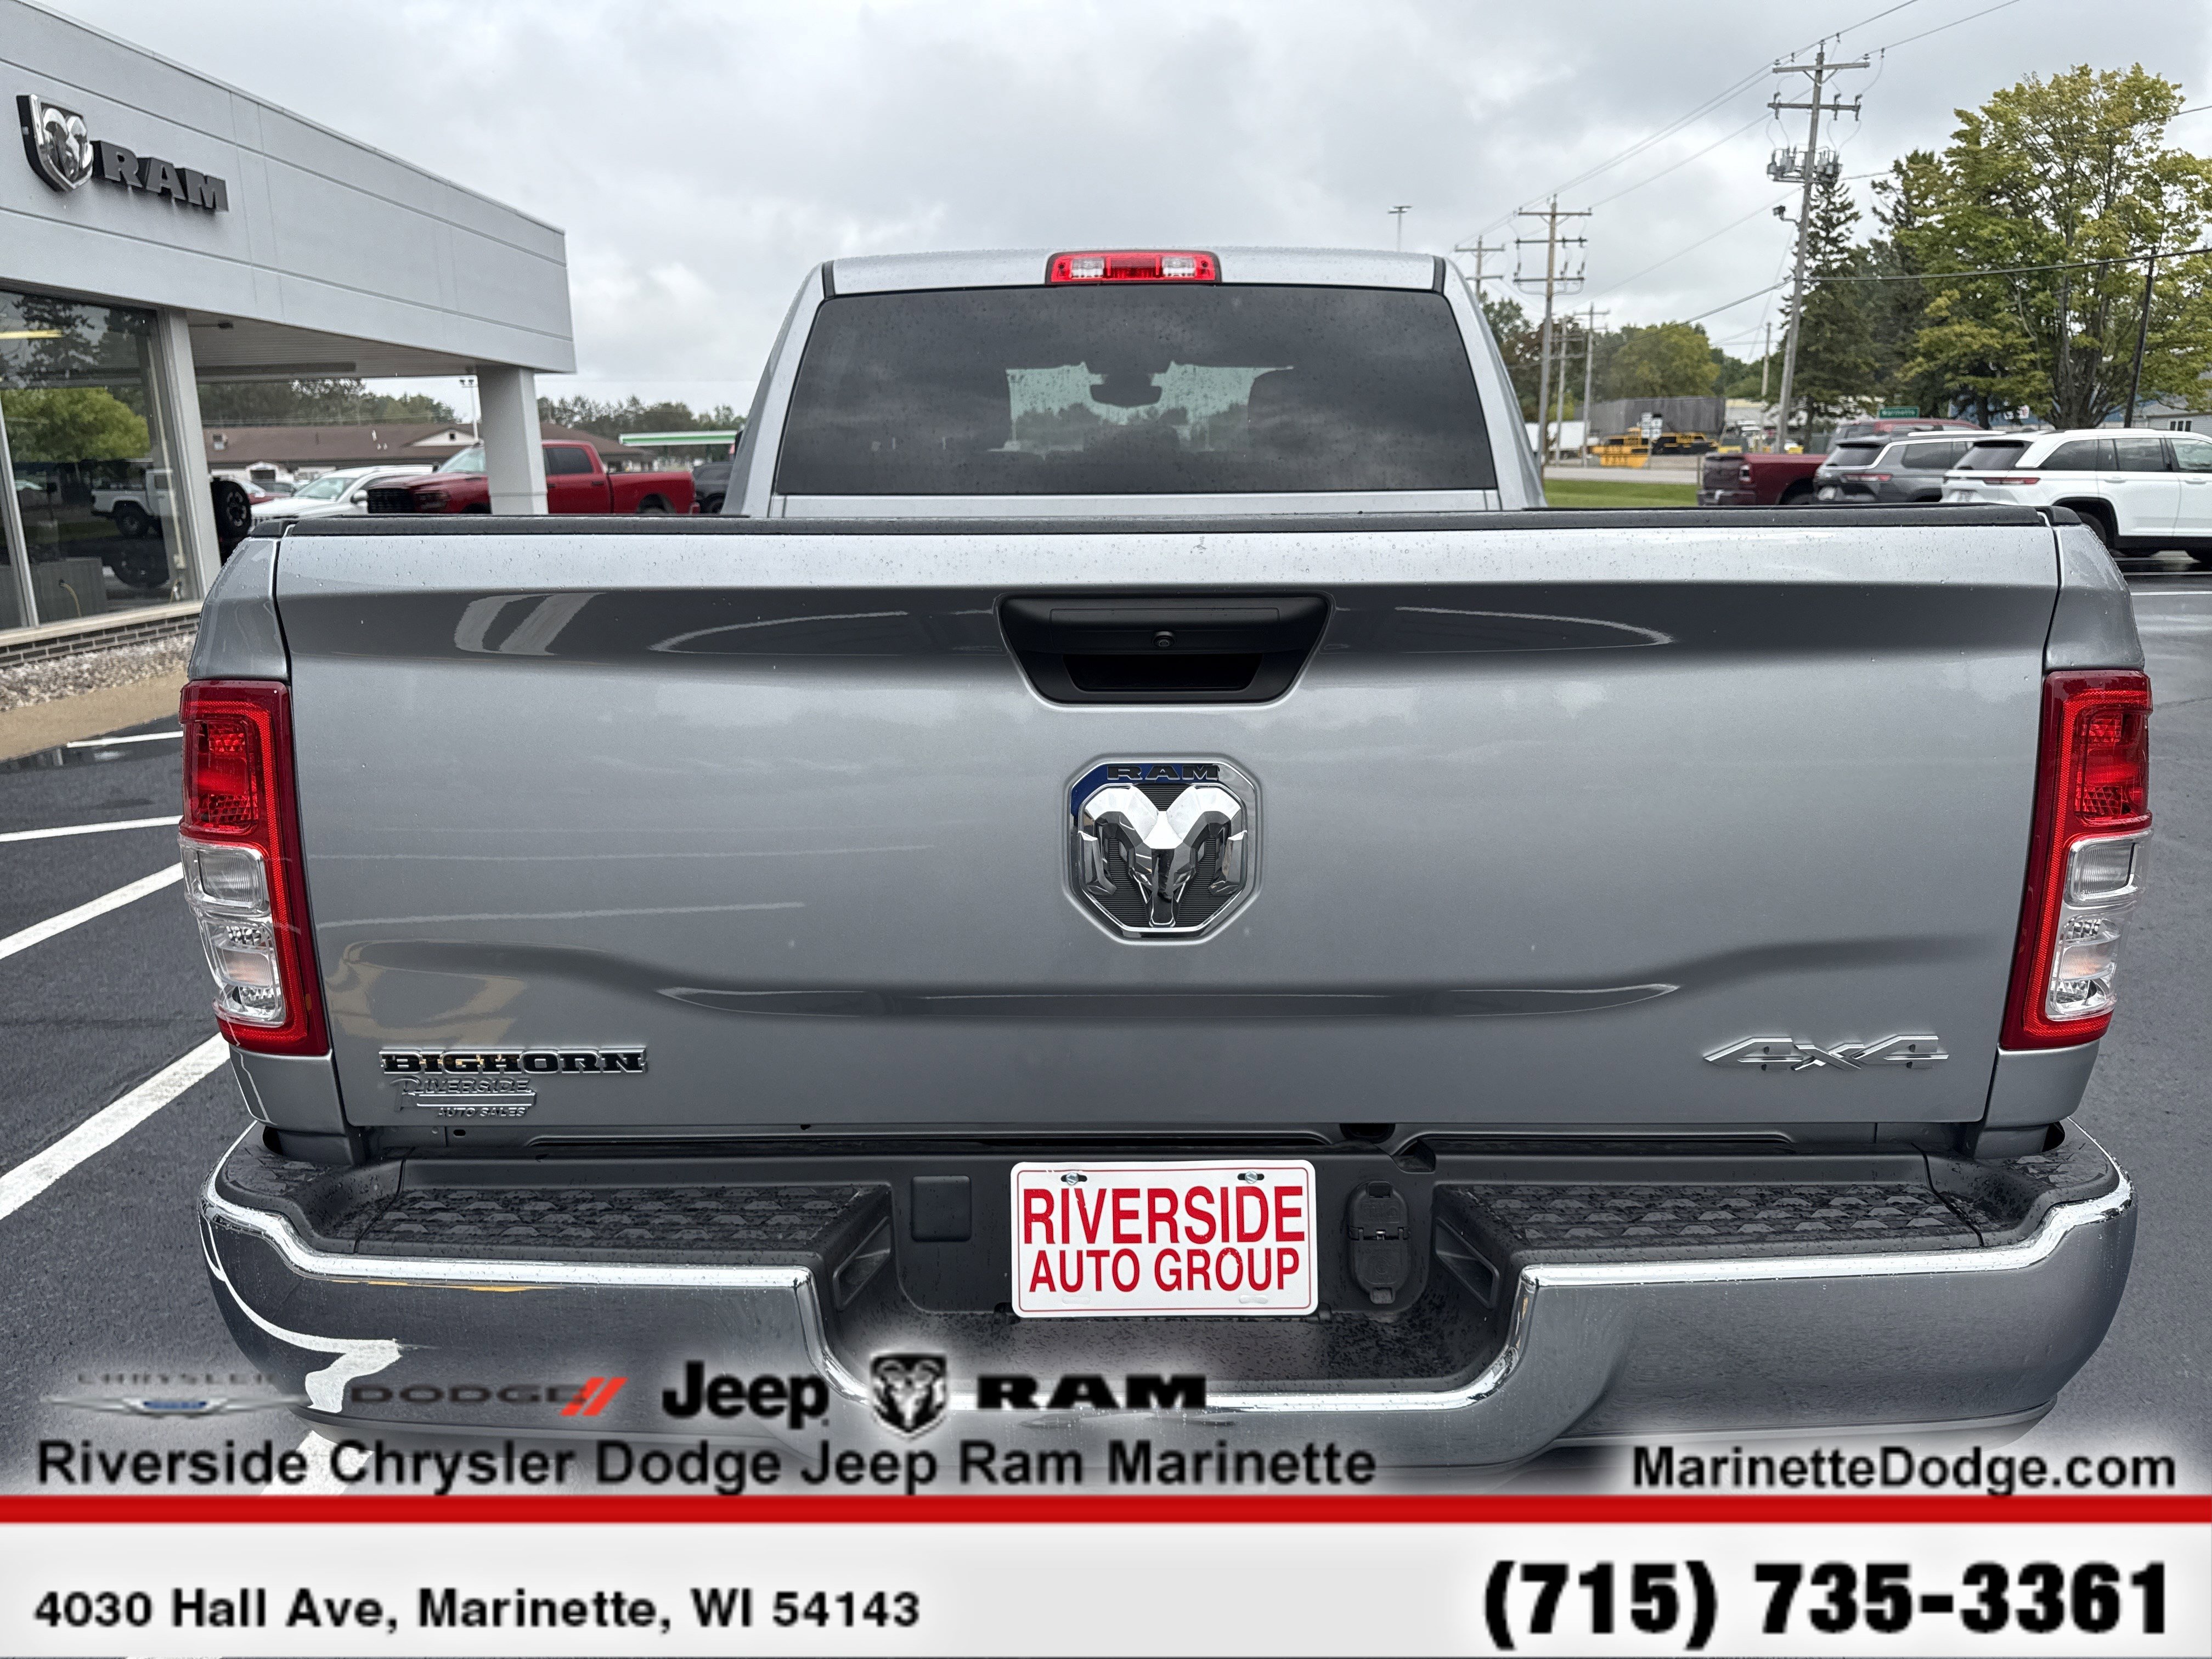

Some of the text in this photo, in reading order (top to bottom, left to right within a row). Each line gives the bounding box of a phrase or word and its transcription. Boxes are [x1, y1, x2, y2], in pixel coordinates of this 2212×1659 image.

[91, 140, 229, 211] RAM
[1107, 765, 1220, 781] RAM
[379, 1048, 647, 1075] BIGHORN
[438, 1107, 528, 1118] AUTO SALES
[1024, 1186, 1305, 1244] RIVERSIDE
[1029, 1247, 1299, 1293] AUTO GROUP
